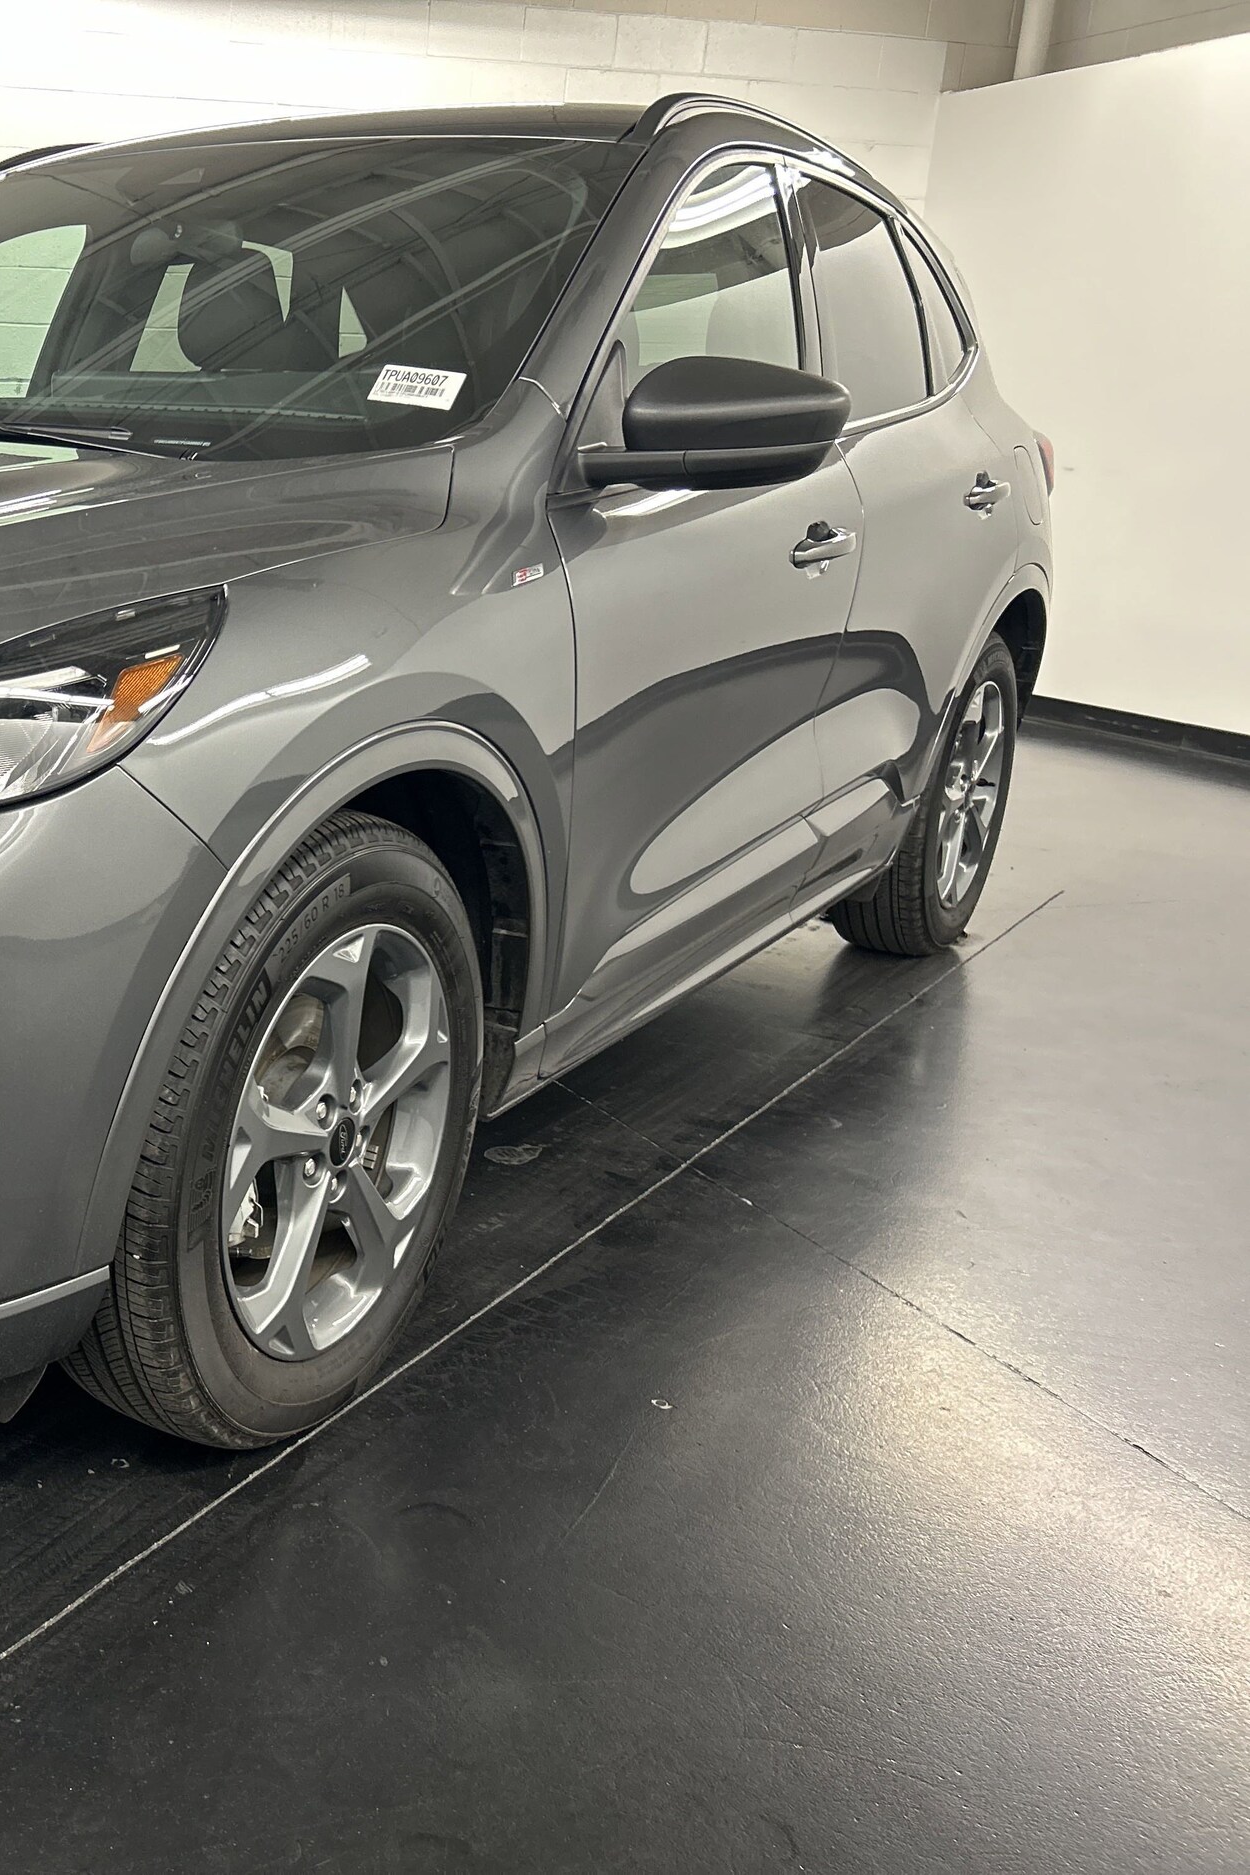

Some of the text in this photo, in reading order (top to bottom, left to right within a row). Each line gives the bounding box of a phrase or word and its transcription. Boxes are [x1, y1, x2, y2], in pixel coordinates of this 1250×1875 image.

[382, 369, 448, 387] TPUA09607
[322, 895, 329, 912] R
[334, 883, 344, 901] 18
[202, 980, 269, 1162] MICHELIN
